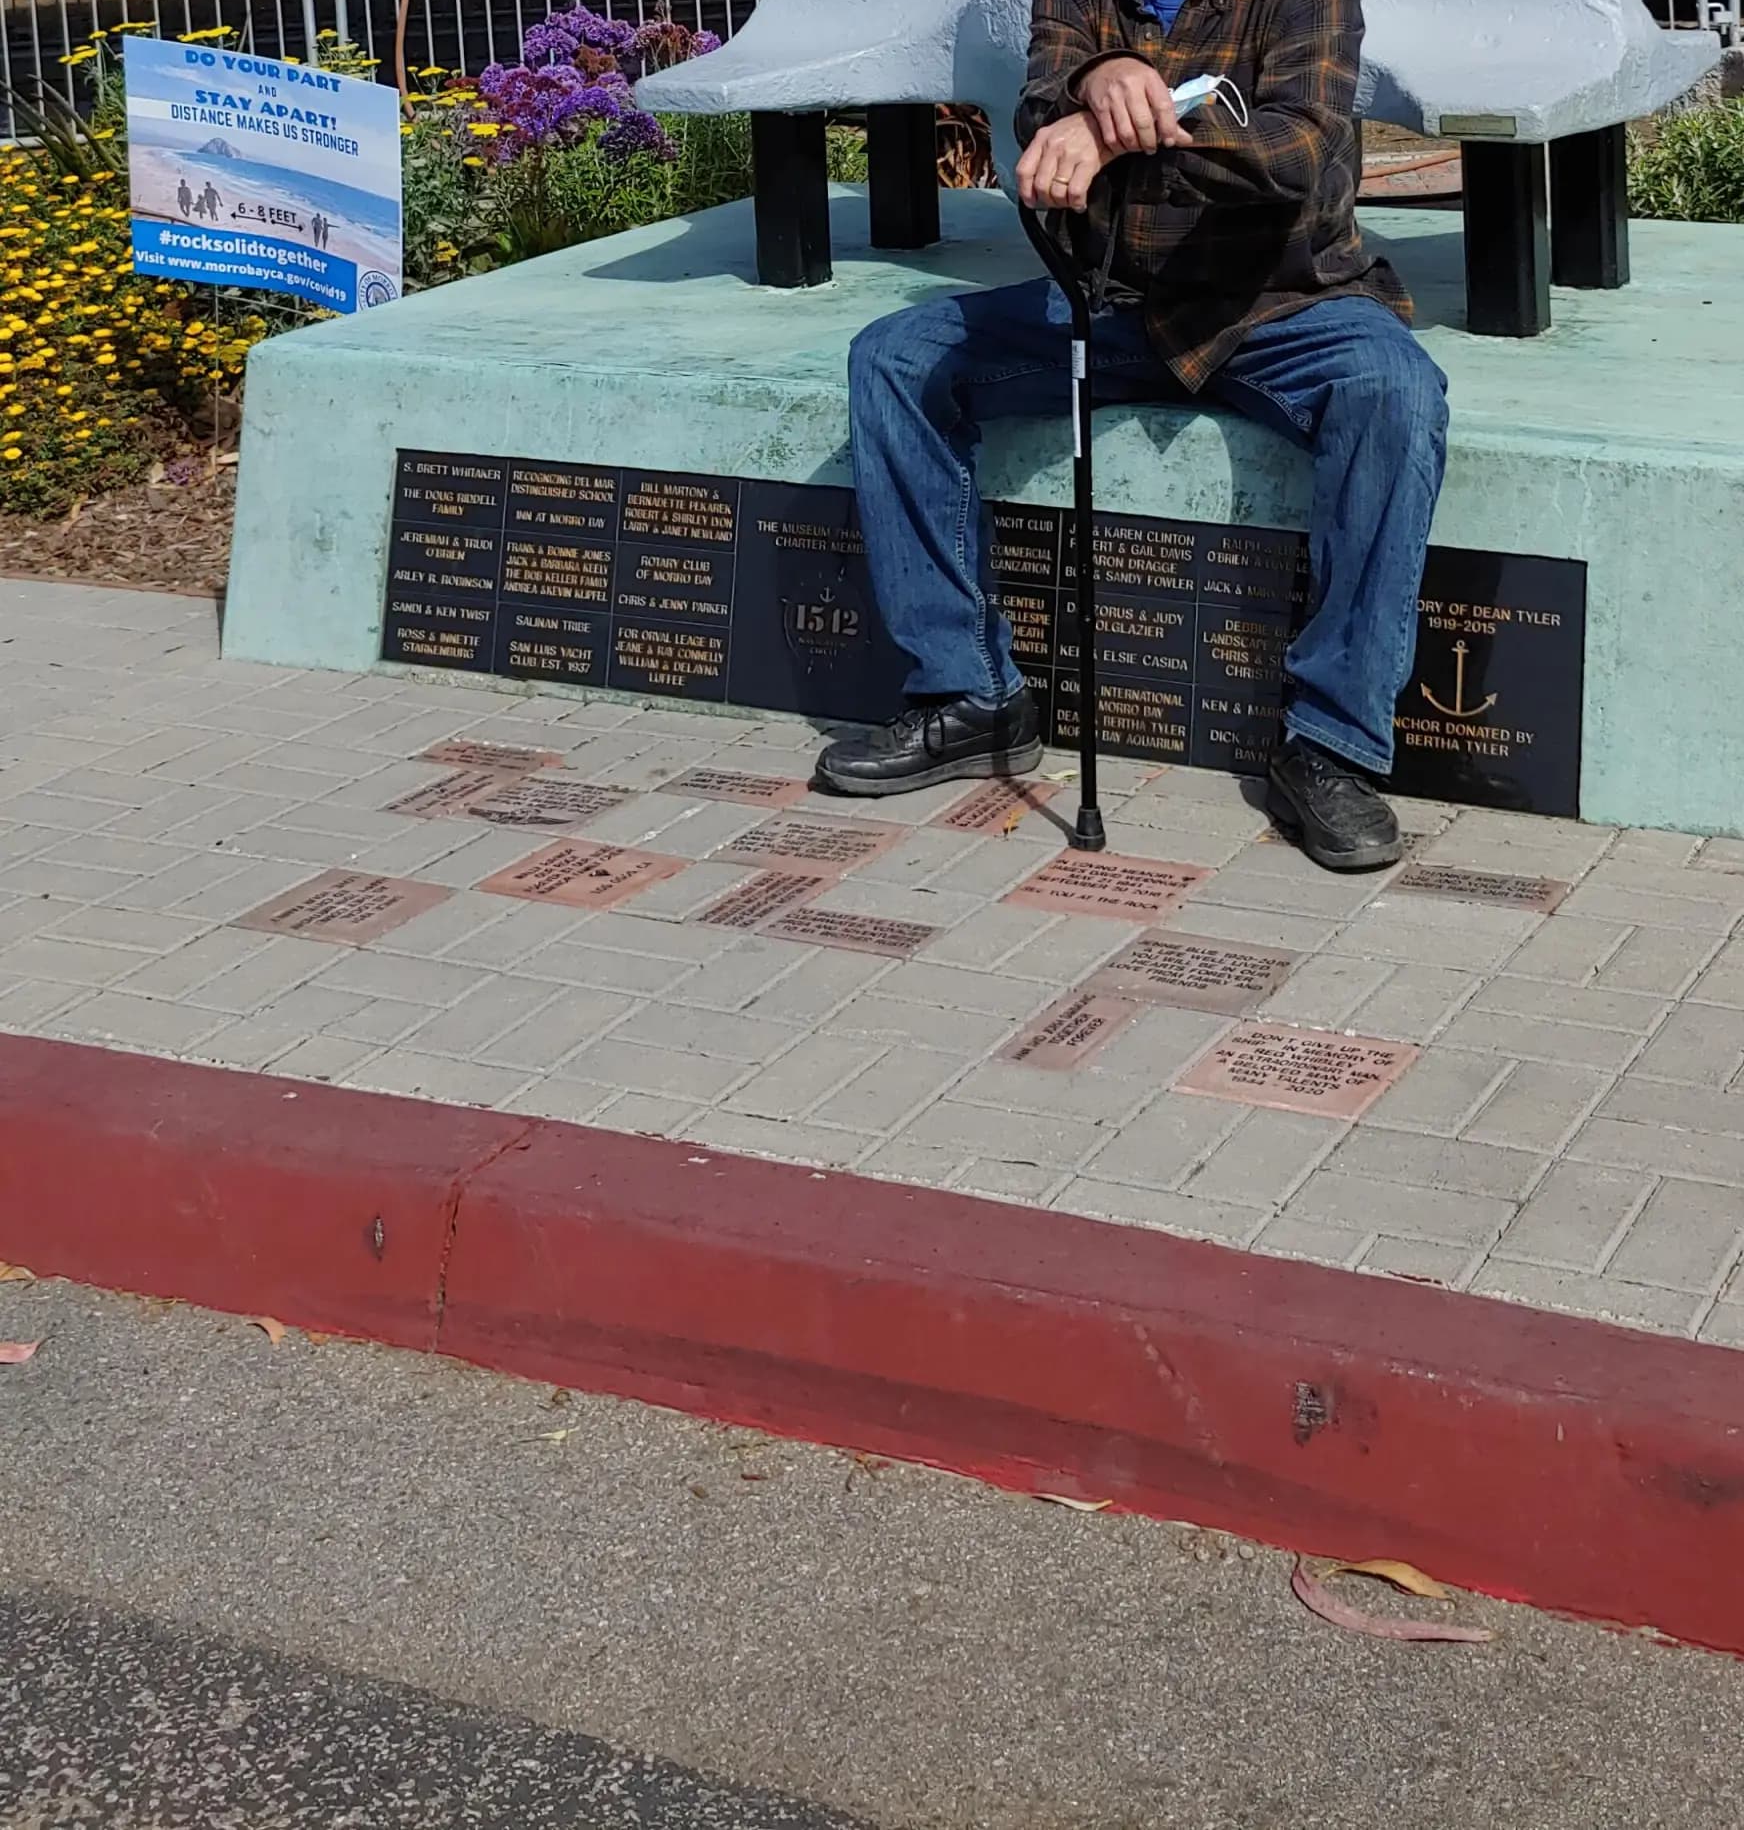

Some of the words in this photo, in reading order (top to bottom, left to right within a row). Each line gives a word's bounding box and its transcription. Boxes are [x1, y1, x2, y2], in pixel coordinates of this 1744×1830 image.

[184, 49, 216, 68] DO
[222, 54, 281, 80] YOUR
[287, 68, 342, 94] PART
[258, 84, 278, 98] AND
[195, 89, 254, 111] STAY
[260, 98, 338, 131] APART!
[170, 103, 234, 128] DISTANCE
[237, 113, 280, 137] MAKES
[283, 121, 299, 141] US
[301, 126, 360, 157] STRONGER
[237, 202, 246, 215] 6
[257, 204, 266, 218] 8
[268, 207, 297, 224] FEET
[136, 249, 165, 266] Visit
[159, 229, 328, 275] #rocksolidtogether
[416, 463, 449, 476] BRETT
[451, 466, 502, 480] WHITAKER
[512, 470, 572, 486] RECOGNIZING
[403, 487, 422, 500] THE
[425, 489, 454, 503] DOUG
[511, 483, 577, 499] DISTINGUISHED
[579, 490, 617, 503] SCHOOL
[640, 481, 660, 494] BILL
[431, 503, 465, 517] FAMILY
[627, 493, 687, 511] BERNADETTE
[535, 512, 547, 523] AT
[549, 513, 586, 527] MORRO
[588, 516, 606, 530] BAY
[625, 507, 659, 521] ROBERT
[671, 513, 709, 527] SHIRLEY
[994, 515, 1025, 530] YACHT
[1027, 519, 1055, 533] CLUB
[623, 520, 650, 533] LARRY
[690, 528, 733, 542] NEWLAND
[756, 520, 779, 534] THE
[782, 522, 832, 538] MUSEUM
[1104, 526, 1143, 541] KAREN
[1146, 530, 1196, 547] CLINTON
[400, 531, 449, 547] JEREMIAH
[464, 537, 493, 551] TRUDI
[775, 536, 827, 552] CHARTER
[506, 554, 528, 567] JACK
[582, 550, 612, 563] JONES
[990, 544, 1053, 562] COMMERCIAL
[1118, 542, 1126, 554] &
[1130, 544, 1157, 558] GAIL
[1160, 547, 1193, 562] DAVIS
[640, 555, 679, 570] ROTARY
[683, 560, 711, 572] CLUB
[1128, 558, 1179, 575] DRAGGE
[440, 575, 494, 590] ROBINSON
[505, 568, 521, 580] THE
[580, 575, 609, 589] FAMILY
[635, 568, 650, 581] OF
[653, 570, 692, 585] MORRO
[694, 574, 713, 587] BAY
[1105, 570, 1142, 585] SANDY
[1147, 575, 1195, 591] FOWLER
[1203, 580, 1232, 594] JACK
[392, 601, 422, 615] SANDI
[436, 606, 457, 619] KEN
[461, 608, 491, 622] TWIST
[618, 593, 647, 607] CHRIS
[659, 598, 689, 611] JENNY
[692, 601, 729, 616] PARKER
[515, 614, 559, 631] SALINAN
[561, 619, 593, 634] TRIBE
[1138, 609, 1147, 621] &
[1153, 612, 1185, 626] JUDY
[1448, 602, 1468, 616] OF
[1473, 604, 1512, 621] DEAN
[1516, 609, 1561, 627] TYLER
[397, 627, 426, 640] ROSS
[1427, 616, 1497, 635] 1919-2015
[618, 627, 639, 640] FOR
[641, 630, 672, 644] ORVAL
[709, 637, 724, 650] BY
[509, 640, 532, 654] SAN
[534, 643, 558, 657] LUIS
[560, 646, 593, 661] YACHT
[677, 648, 724, 664] CONNELLY
[1103, 649, 1139, 665] ELSIE
[1142, 654, 1189, 671] CASIDA
[1211, 647, 1250, 664] CHRIS
[509, 654, 538, 668] CLUB
[567, 662, 592, 675] 1937
[618, 654, 660, 670] WILLIAM
[1100, 684, 1186, 707] INTERNATIONAL
[1098, 699, 1140, 716] MORRO
[1143, 705, 1165, 719] BAY
[1201, 698, 1229, 713] KEN
[1232, 702, 1242, 715] &
[1103, 714, 1147, 731] BERTHA
[1150, 721, 1187, 738] TYLER
[1390, 717, 1441, 733] NCHOR
[1445, 721, 1511, 741] DONATED
[1516, 730, 1535, 745] BY
[1101, 729, 1122, 744] BAY
[1126, 732, 1186, 752] AQUARIUM
[1209, 729, 1241, 744] DICK
[1405, 733, 1460, 751] BERTHA
[1464, 739, 1510, 757] TYLER
